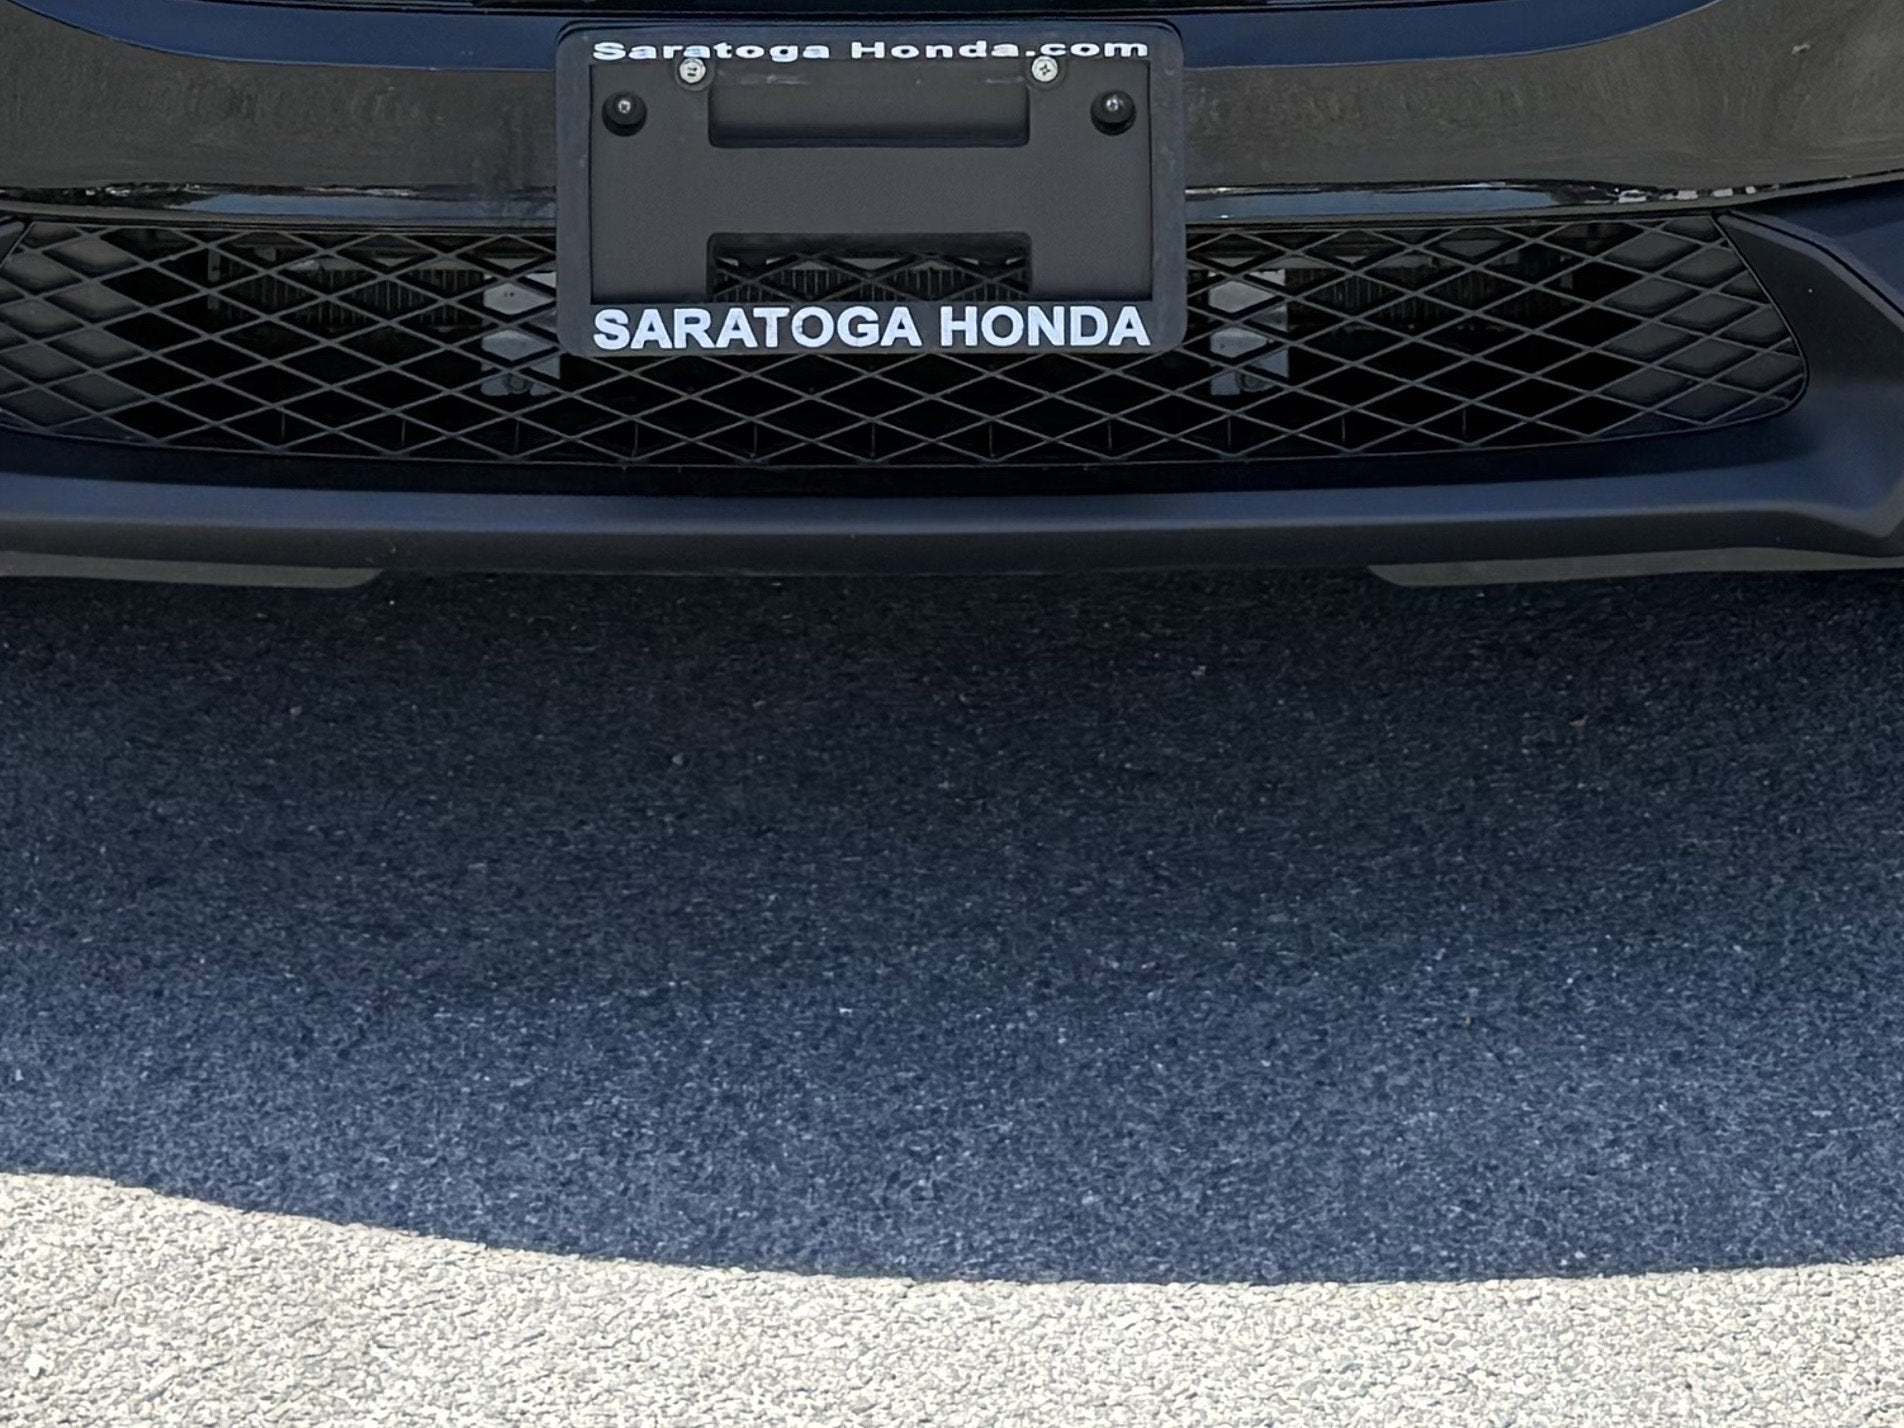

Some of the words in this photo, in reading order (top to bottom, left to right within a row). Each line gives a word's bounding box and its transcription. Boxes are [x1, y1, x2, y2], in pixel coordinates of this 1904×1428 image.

[592, 41, 831, 63] Saratoga
[850, 39, 1150, 60] Honda.com
[593, 305, 923, 350] SARATOGA
[940, 304, 1151, 347] HONDA
